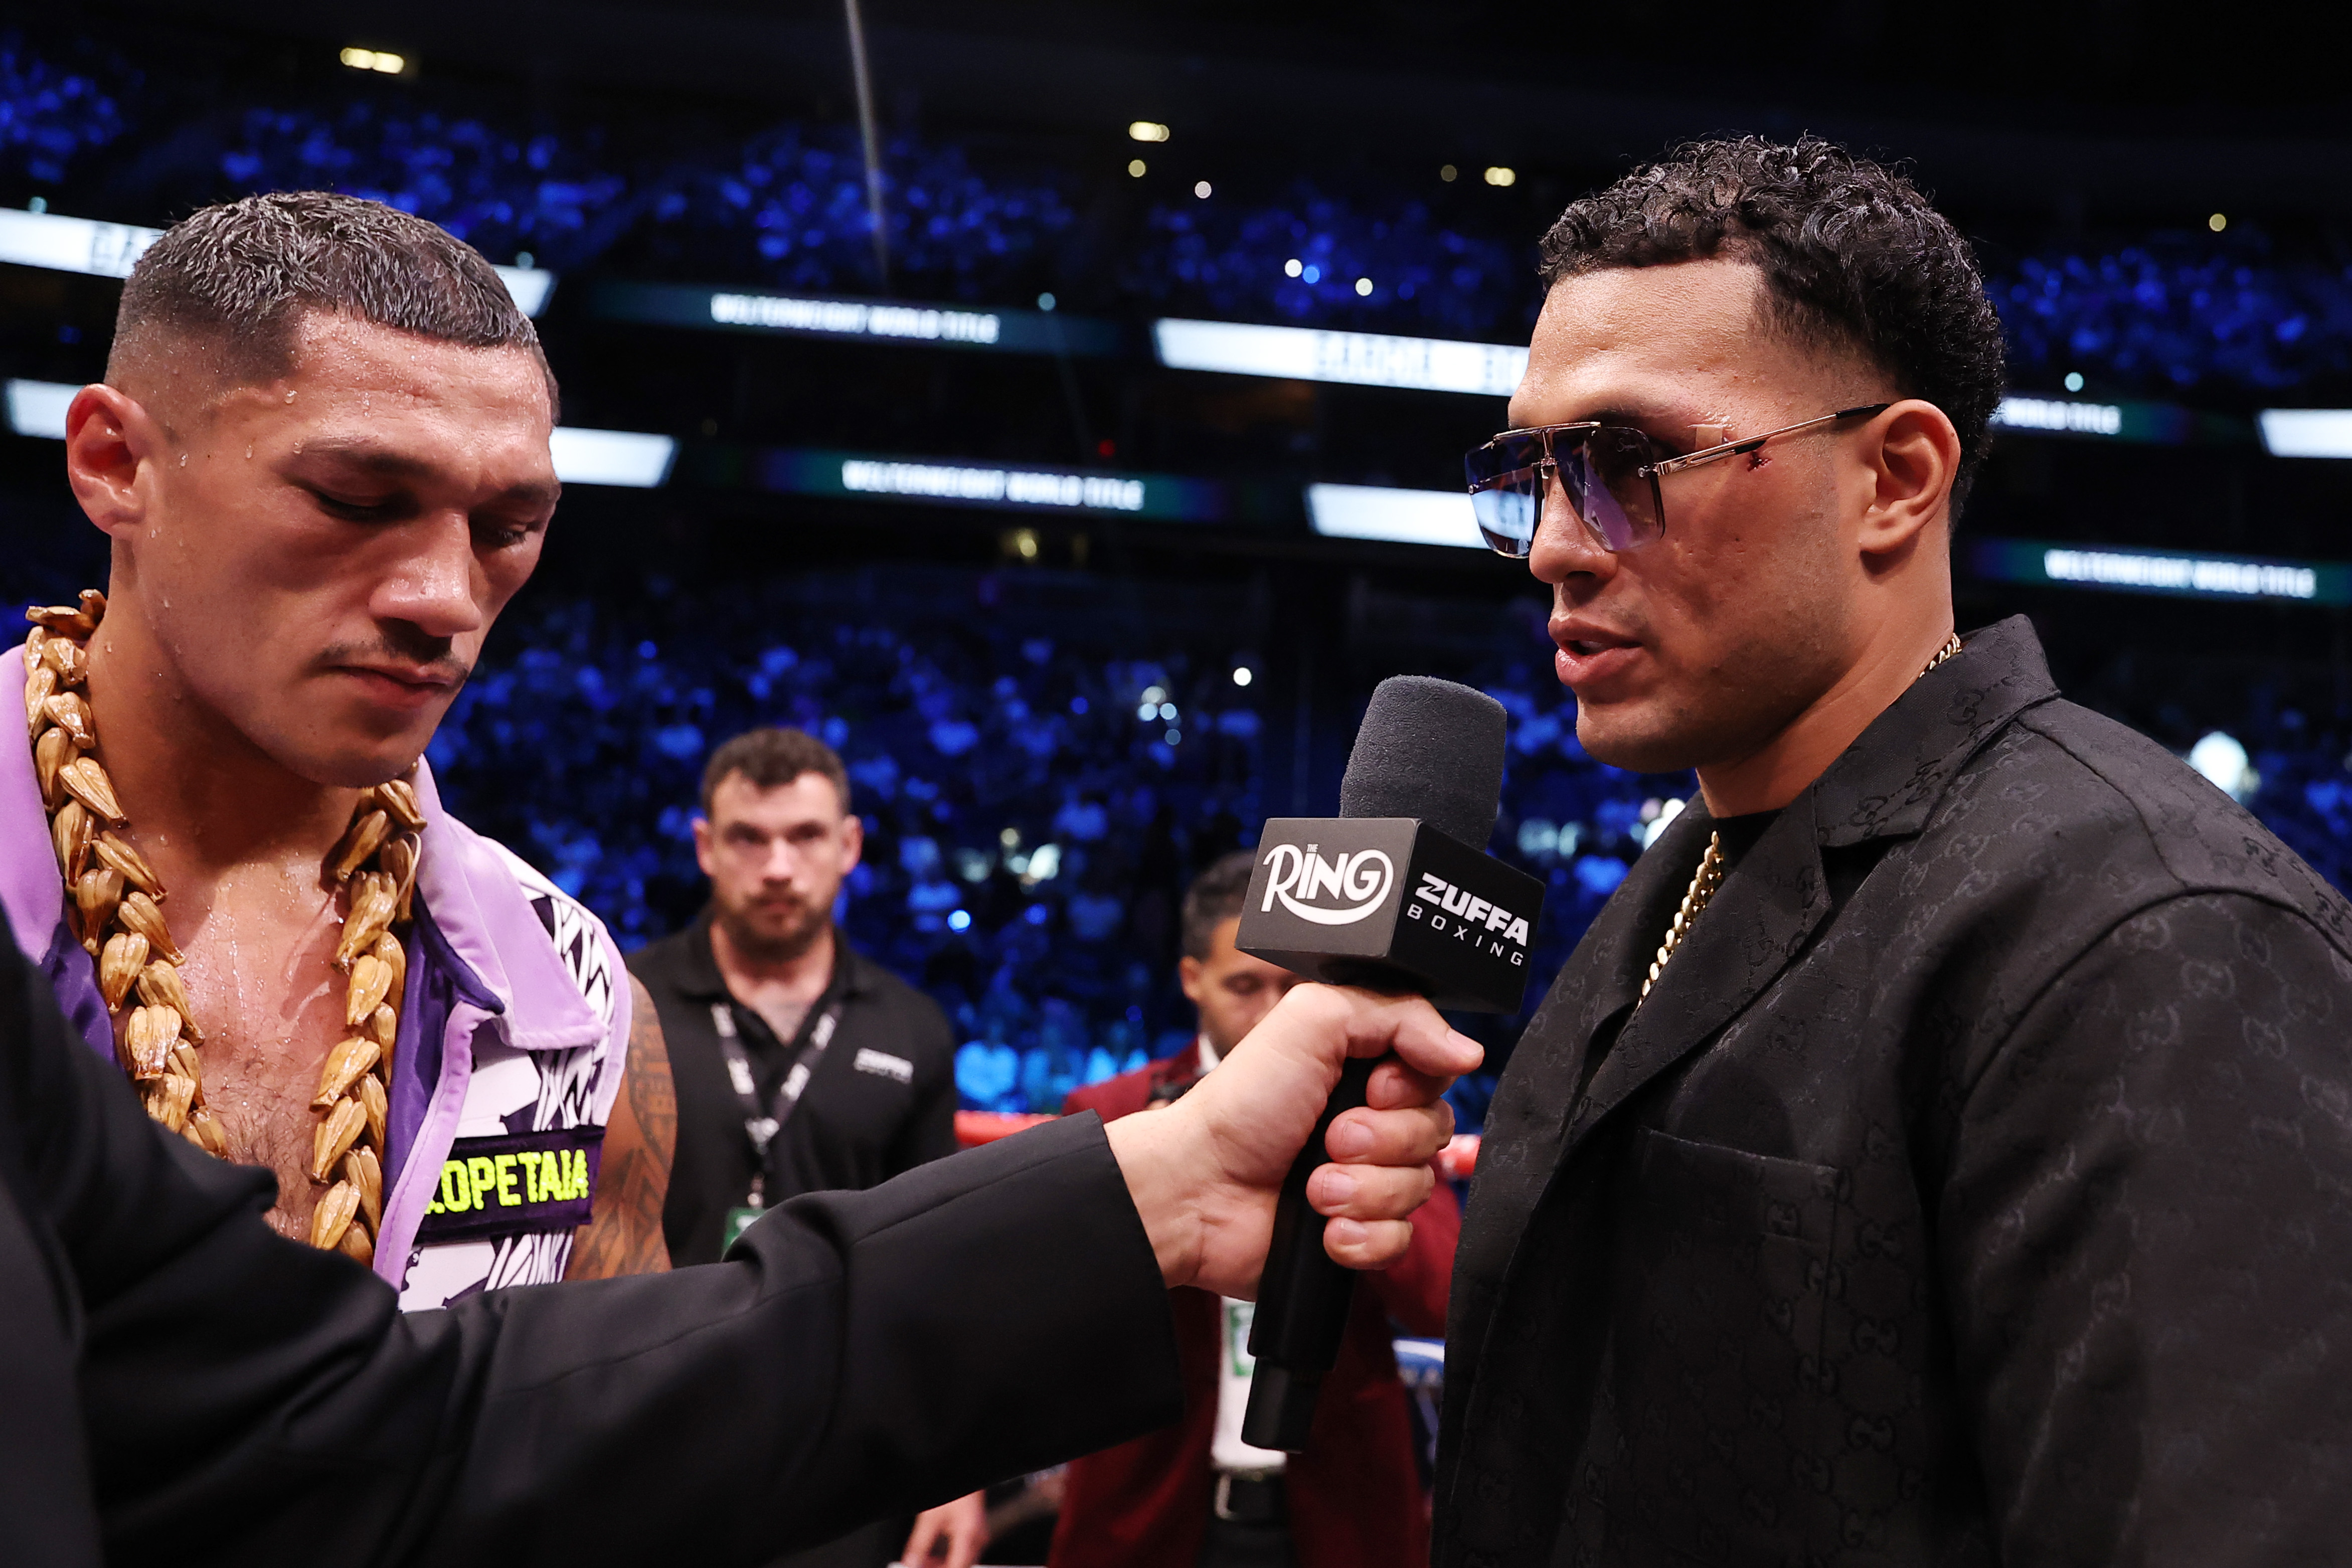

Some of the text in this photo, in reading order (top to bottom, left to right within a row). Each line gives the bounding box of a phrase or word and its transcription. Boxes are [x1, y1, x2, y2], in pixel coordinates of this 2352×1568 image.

[1306, 843, 1318, 852] THE
[1261, 844, 1394, 925] RING
[1415, 872, 1529, 947] ZUFFA
[1407, 903, 1524, 966] BOXING
[425, 1149, 589, 1214] OPETAIA
